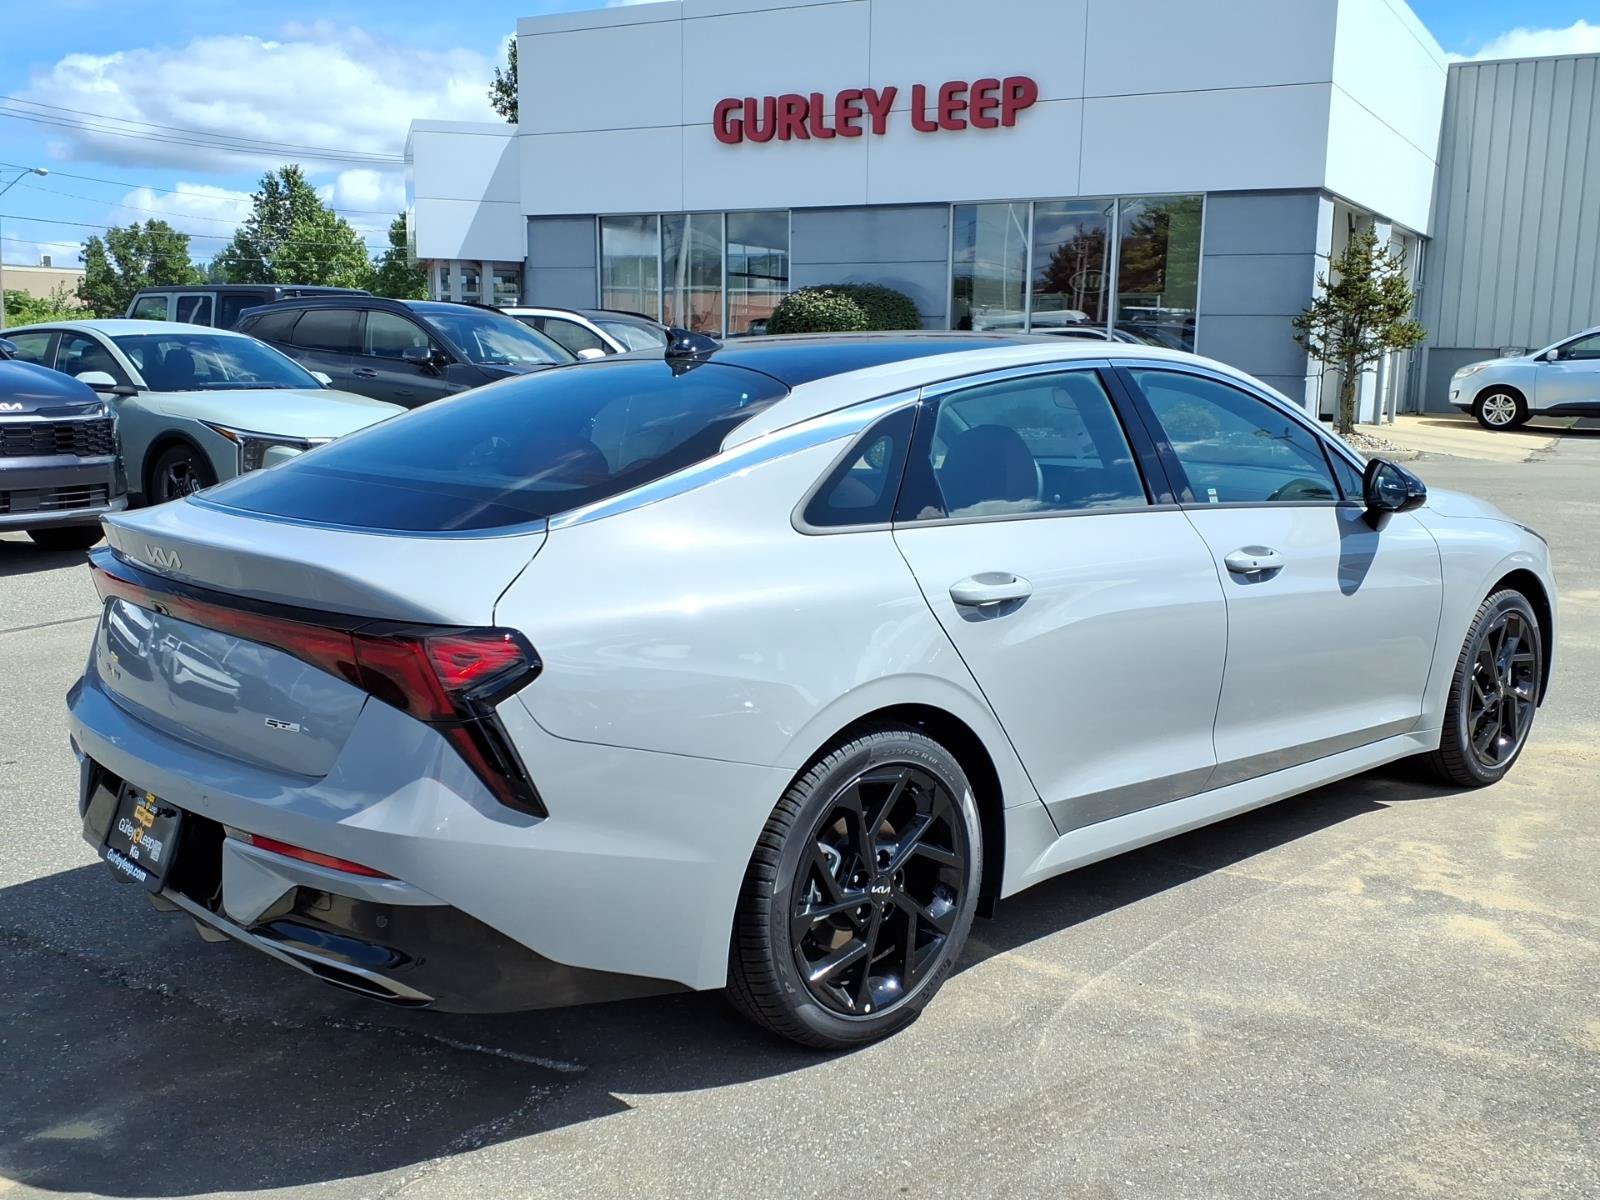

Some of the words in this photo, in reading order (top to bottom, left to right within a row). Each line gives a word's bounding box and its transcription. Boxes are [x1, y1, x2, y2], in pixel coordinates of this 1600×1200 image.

[713, 86, 898, 144] GURLEY
[911, 76, 1038, 132] LEEP
[145, 543, 182, 569] KIA
[140, 834, 156, 851] Leep
[129, 844, 140, 859] Kia
[871, 885, 891, 894] KIA
